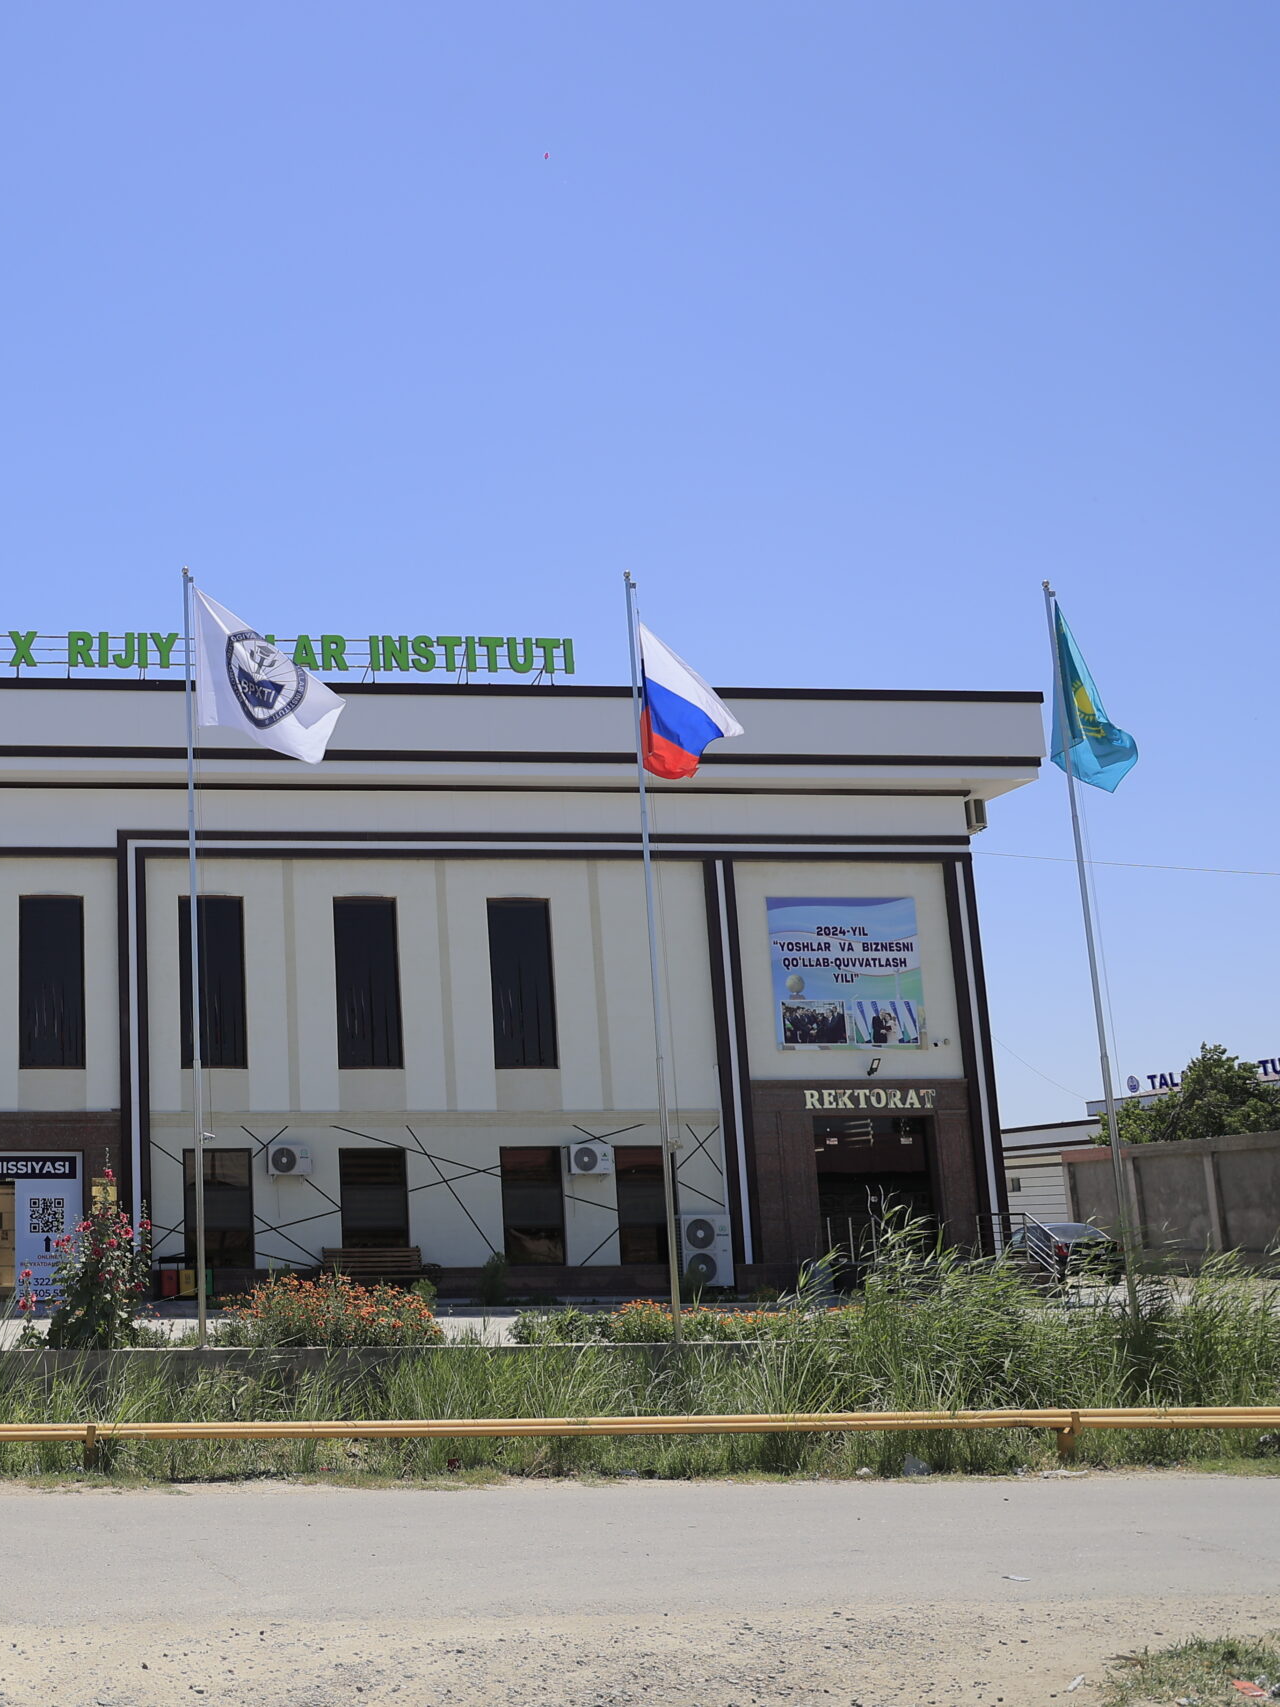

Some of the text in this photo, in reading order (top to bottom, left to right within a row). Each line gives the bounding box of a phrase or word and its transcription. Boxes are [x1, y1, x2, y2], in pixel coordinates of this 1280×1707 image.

[370, 635, 574, 674] INSTITUTI
[240, 679, 276, 703] BPXTI
[272, 692, 302, 721] INSTITUTI
[816, 926, 868, 937] 2024-YIL
[839, 942, 854, 952] VA
[862, 941, 914, 952] BIZNESNI
[804, 1088, 936, 1110] REKTORAT
